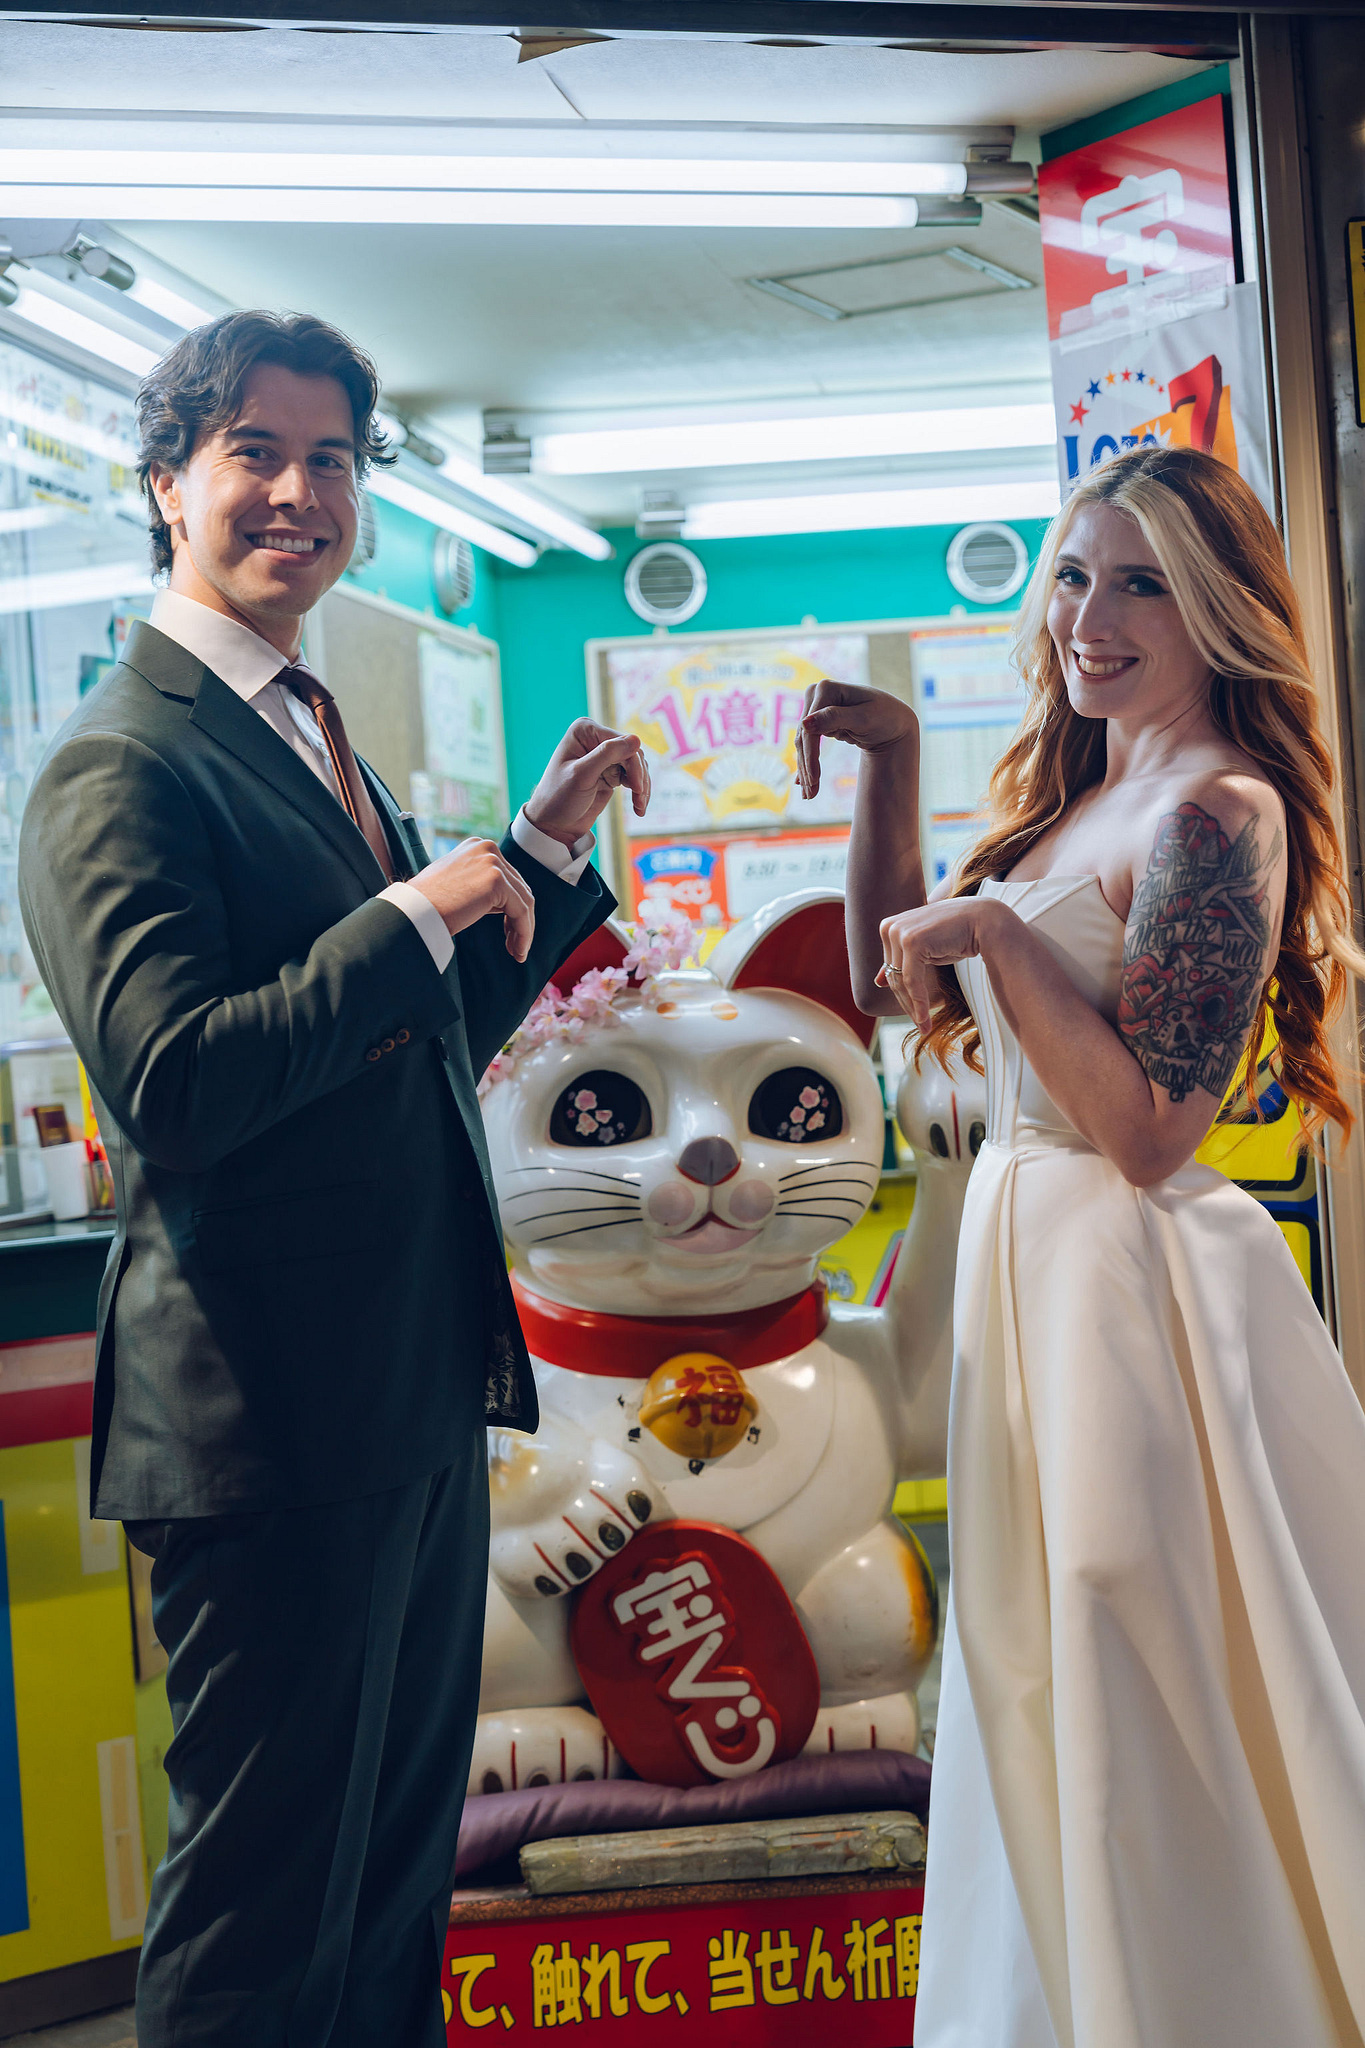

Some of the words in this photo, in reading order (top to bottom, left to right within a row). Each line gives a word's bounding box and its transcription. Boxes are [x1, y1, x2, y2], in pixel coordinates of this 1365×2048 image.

[1183, 918, 1217, 942] the
[674, 1365, 745, 1427] 福
[613, 1560, 776, 1779] 宝くじ
